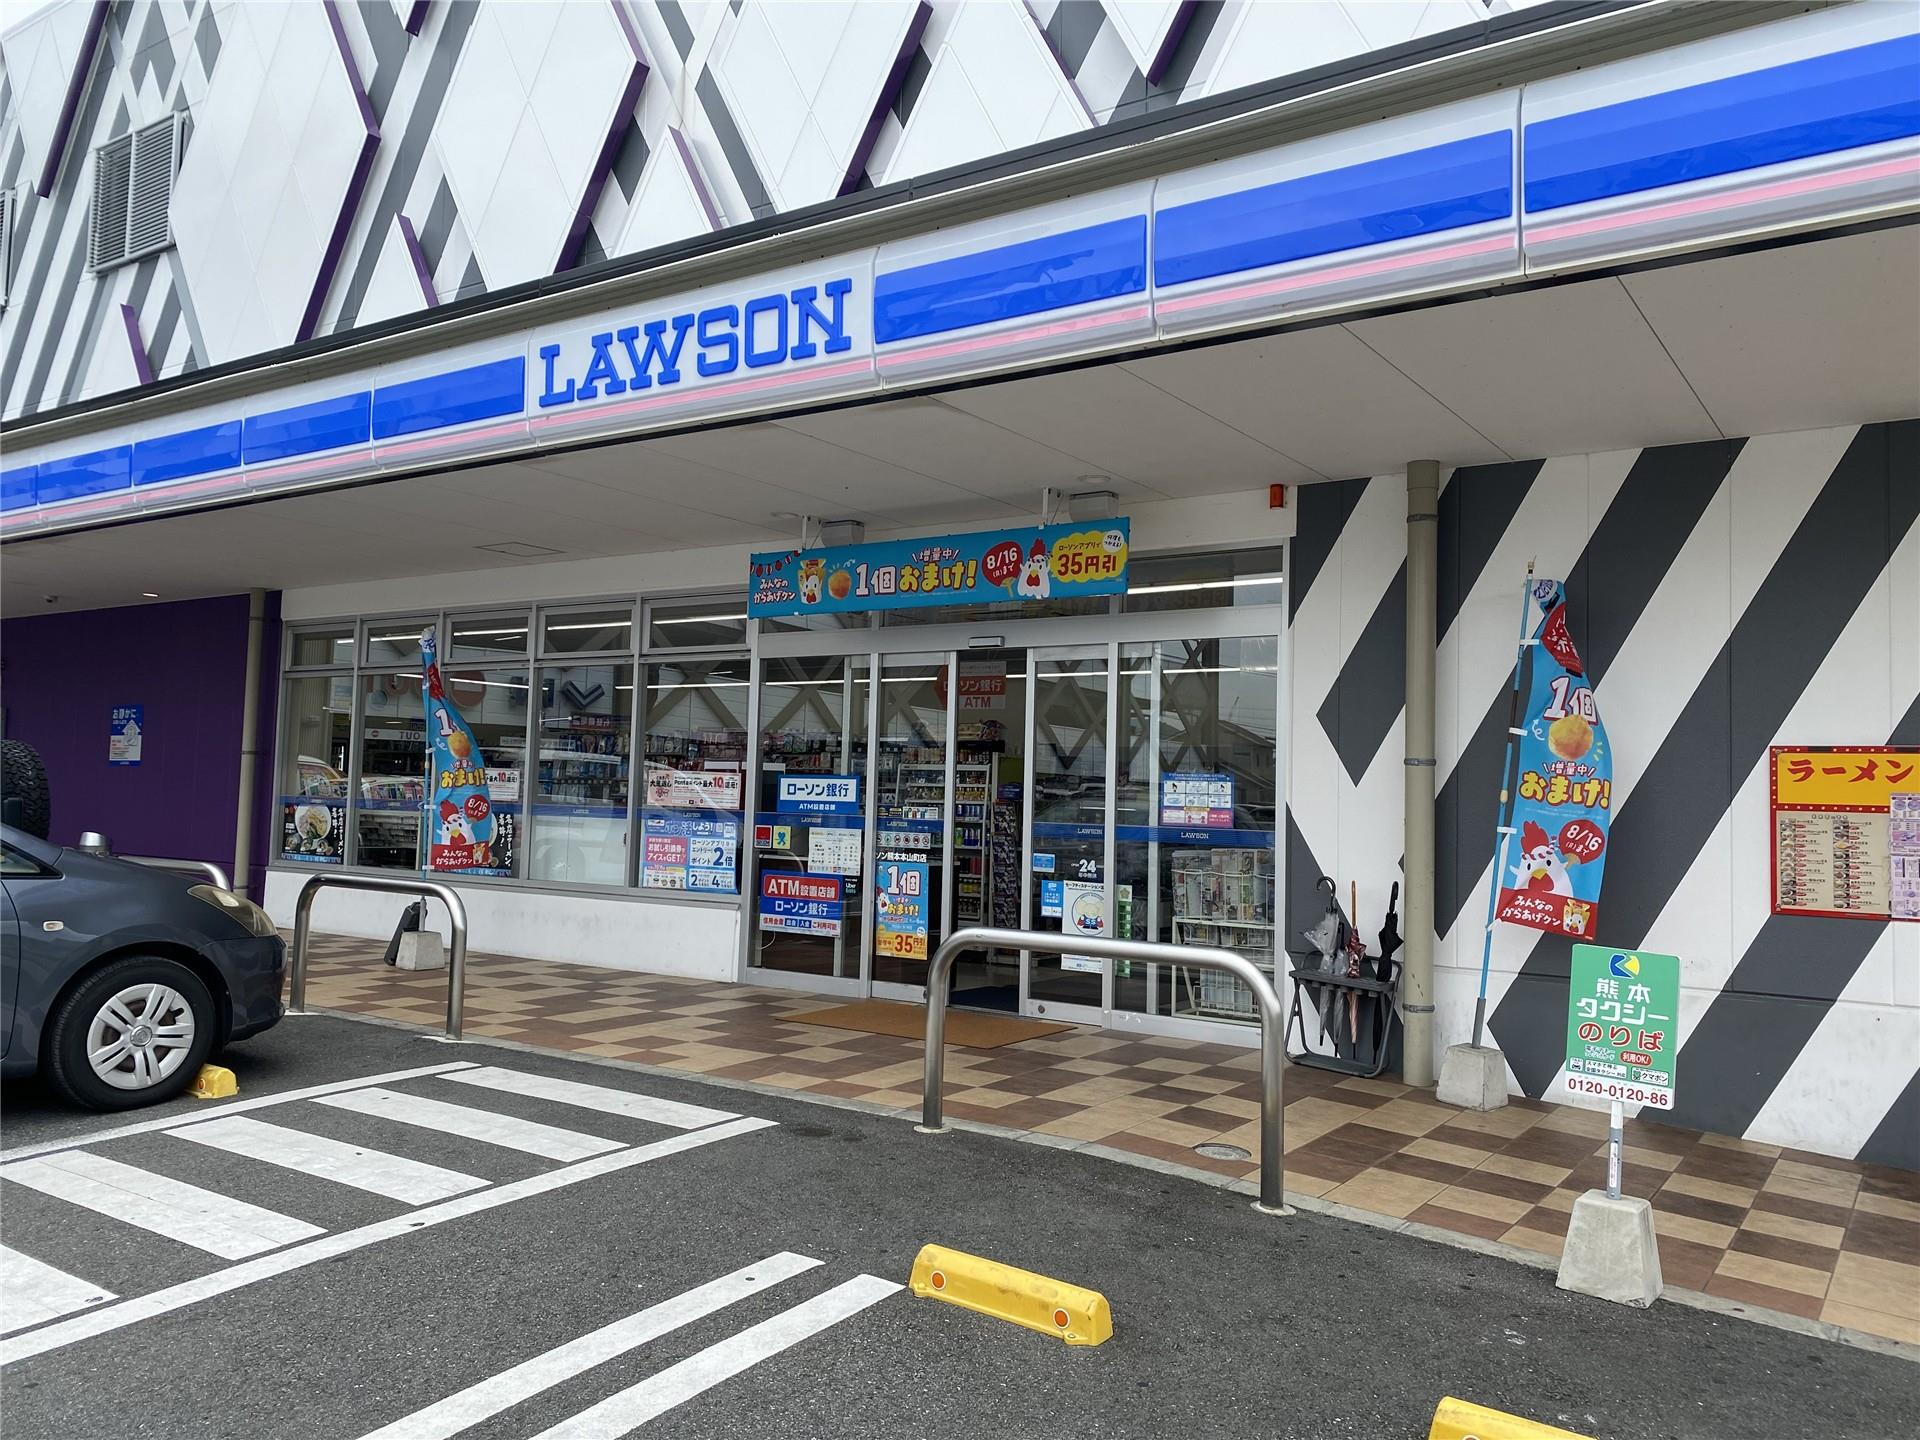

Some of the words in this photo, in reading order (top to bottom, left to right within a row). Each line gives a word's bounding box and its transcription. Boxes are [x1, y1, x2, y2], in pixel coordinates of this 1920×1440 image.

[539, 278, 852, 407] LAWSON
[986, 547, 1018, 570] 8/16
[1057, 552, 1118, 577] 35円引
[759, 577, 789, 591] みんなの
[855, 563, 897, 596] 1個
[899, 560, 977, 593] おまけ!
[753, 590, 797, 605] からあげクン
[964, 697, 991, 708] ATM
[1787, 758, 1915, 784] ラーメン
[787, 783, 849, 797] ローソン銀行
[1519, 770, 1612, 809] おまけ!
[468, 798, 489, 813] 8/16
[1566, 825, 1602, 851] 8/16
[1079, 859, 1097, 872] 24
[767, 878, 836, 899] ATM設置店舗
[887, 865, 921, 896] 1個
[775, 900, 828, 916] ローソン銀行
[1514, 895, 1554, 912] みんなの
[1502, 907, 1561, 927] からあげクン
[1596, 978, 1651, 1004] 熊本
[1576, 998, 1670, 1026] タクシー
[1577, 1021, 1665, 1052] のりば
[1622, 1052, 1650, 1065] 利用OK!
[1568, 1078, 1668, 1106] 0120-0120-86
